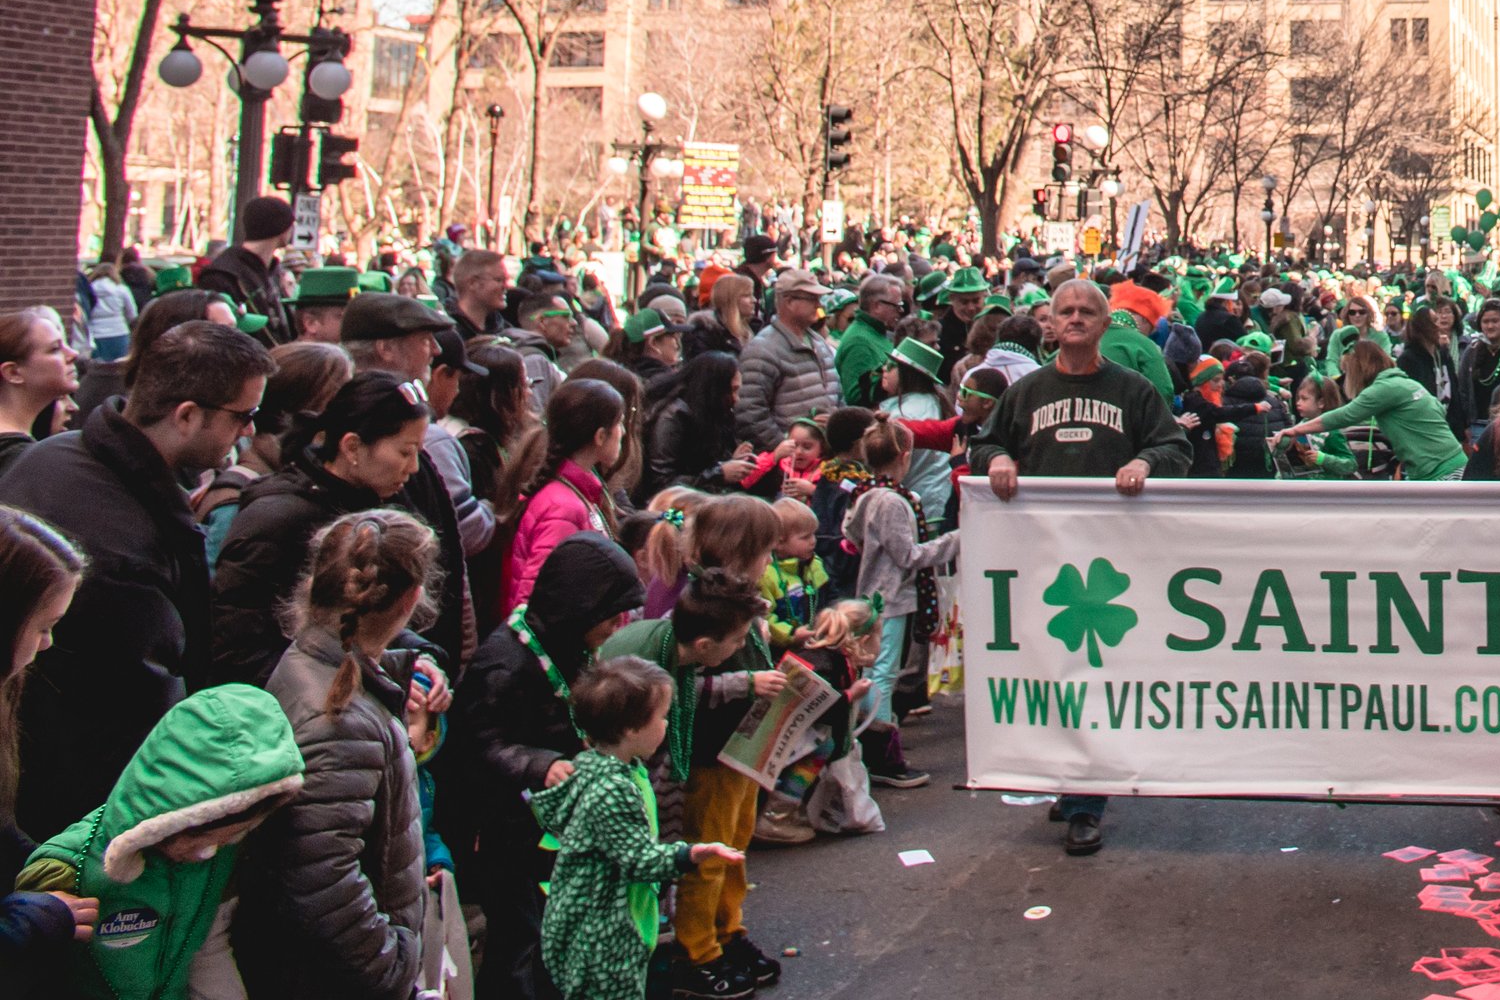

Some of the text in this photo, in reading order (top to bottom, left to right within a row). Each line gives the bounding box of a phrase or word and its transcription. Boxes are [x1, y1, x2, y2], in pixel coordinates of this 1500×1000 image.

[298, 198, 318, 213] ONE
[297, 215, 318, 226] WAY
[1051, 226, 1071, 234] ONE
[1051, 236, 1071, 244] WAY
[1030, 397, 1125, 436] NORTH DAKOTA
[1058, 430, 1090, 439] HOCKEY
[983, 569, 1020, 652] I
[776, 690, 830, 760] IRISH GAZETTE
[115, 912, 141, 923] Amy
[99, 918, 158, 934] Klobuchar
